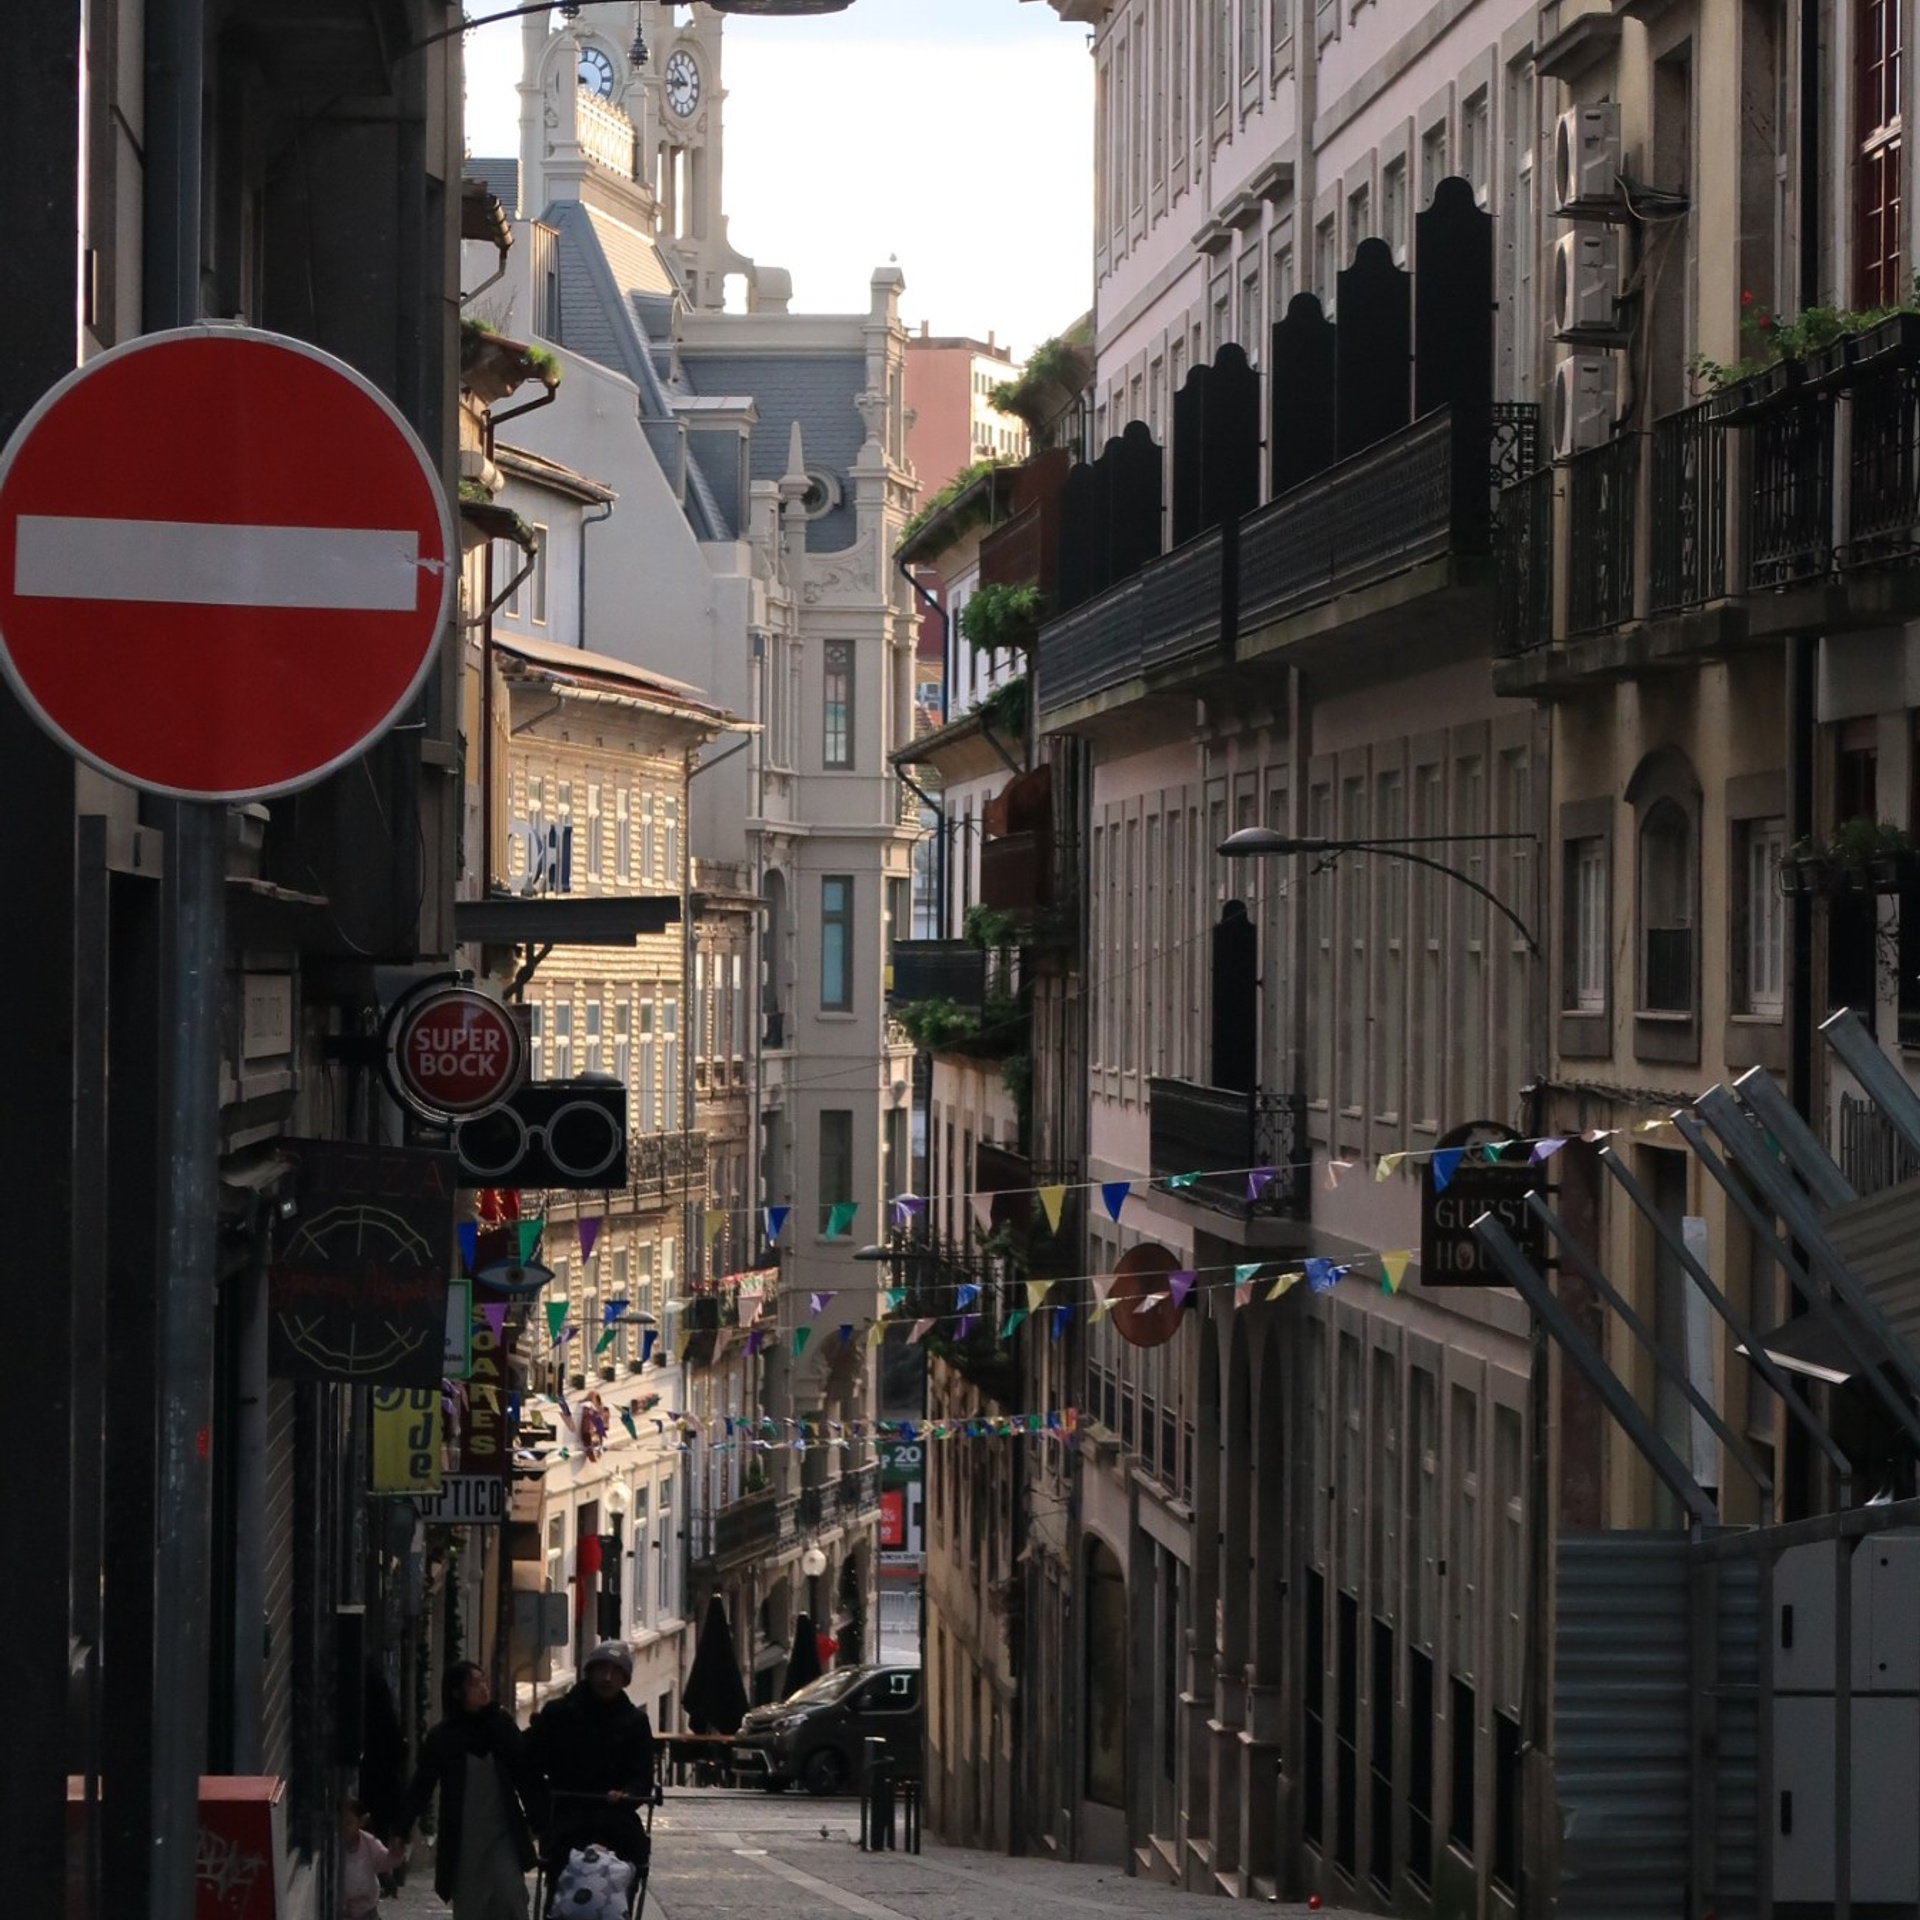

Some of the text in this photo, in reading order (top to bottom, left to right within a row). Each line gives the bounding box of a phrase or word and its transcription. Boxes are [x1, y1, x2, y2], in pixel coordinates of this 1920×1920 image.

[414, 1027, 501, 1053] SUPER
[418, 1052, 497, 1078] BOCK
[894, 1445, 922, 1463] 20
